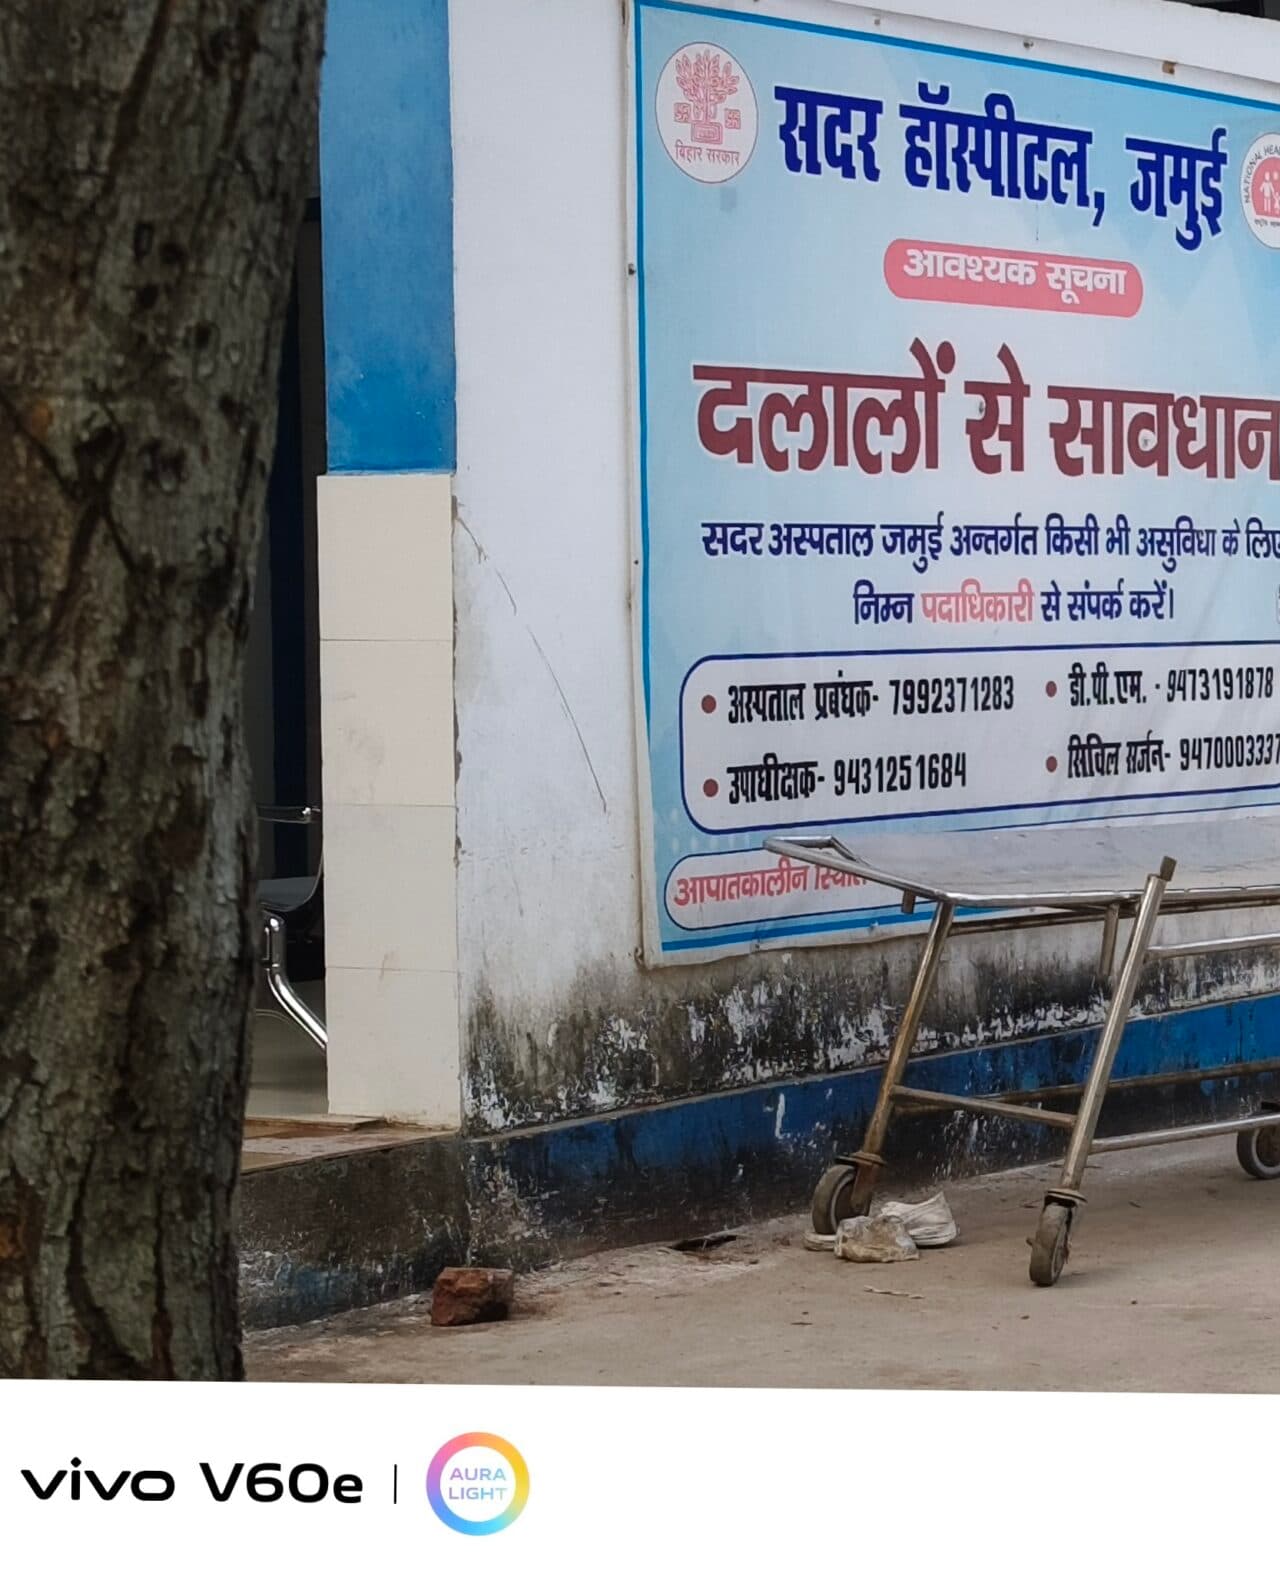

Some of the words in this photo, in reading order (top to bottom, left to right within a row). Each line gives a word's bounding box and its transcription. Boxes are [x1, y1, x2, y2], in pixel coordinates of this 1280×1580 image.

[675, 139, 702, 161] बिहार
[707, 147, 740, 166] सरकार
[774, 85, 883, 182] सदर
[899, 81, 1105, 227] हॉस्पीटल,
[1125, 127, 1227, 251] जमुई
[1243, 151, 1263, 203] NATIONAL
[903, 248, 1038, 286] आवश्यक
[1045, 262, 1127, 304] सूचना
[692, 337, 956, 474] दलालों
[964, 342, 1030, 475] से
[701, 522, 764, 556] सदर
[768, 523, 876, 557] अस्पताल
[880, 511, 944, 574] जमुई
[950, 512, 1038, 556] अन्तर्गत
[1045, 513, 1100, 556] किसी
[1106, 514, 1130, 556] भी
[1136, 515, 1216, 574] असुविधा
[1222, 518, 1240, 558] के
[852, 579, 915, 625] निम्न
[920, 578, 1034, 623] पदाधिकारी
[1041, 580, 1061, 621] से
[1067, 578, 1123, 621] संपर्क
[1129, 579, 1174, 620] करें।
[727, 682, 806, 724] अस्पताल
[889, 675, 1014, 715] 7992371283
[1068, 661, 1147, 707] डी.पी.एम.
[1167, 666, 1274, 702] 9473191878
[833, 752, 967, 796] 9431251684
[1067, 734, 1121, 778] सिविल
[673, 856, 810, 906] आपातकालीन
